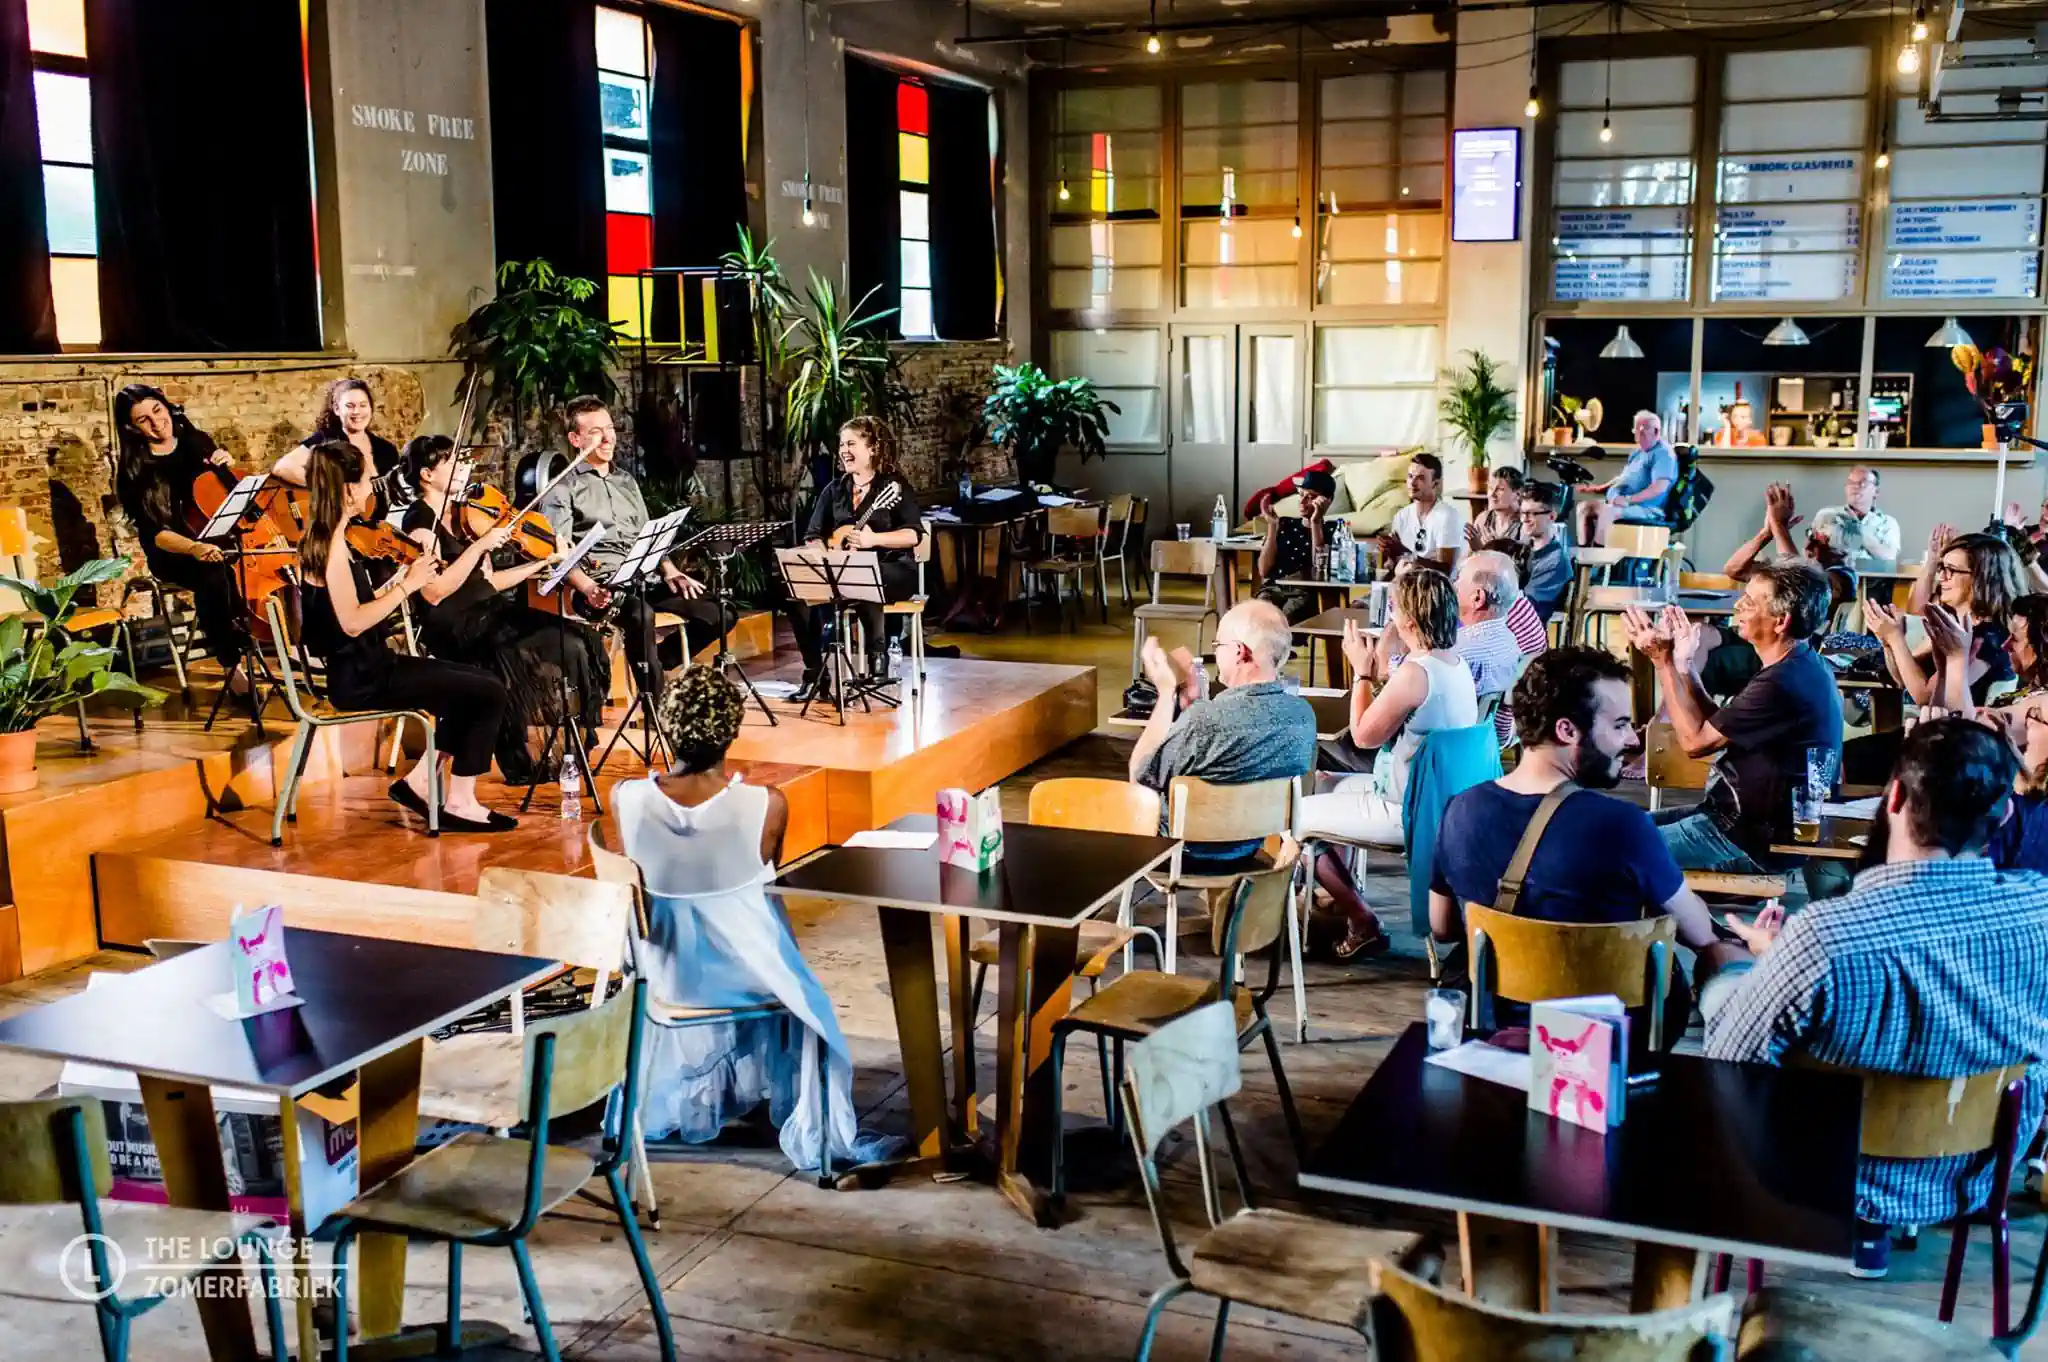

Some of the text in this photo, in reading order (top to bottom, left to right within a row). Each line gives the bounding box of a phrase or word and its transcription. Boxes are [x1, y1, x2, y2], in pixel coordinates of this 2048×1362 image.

[351, 104, 475, 140] SMOKE FREE
[401, 149, 449, 176] ZONE
